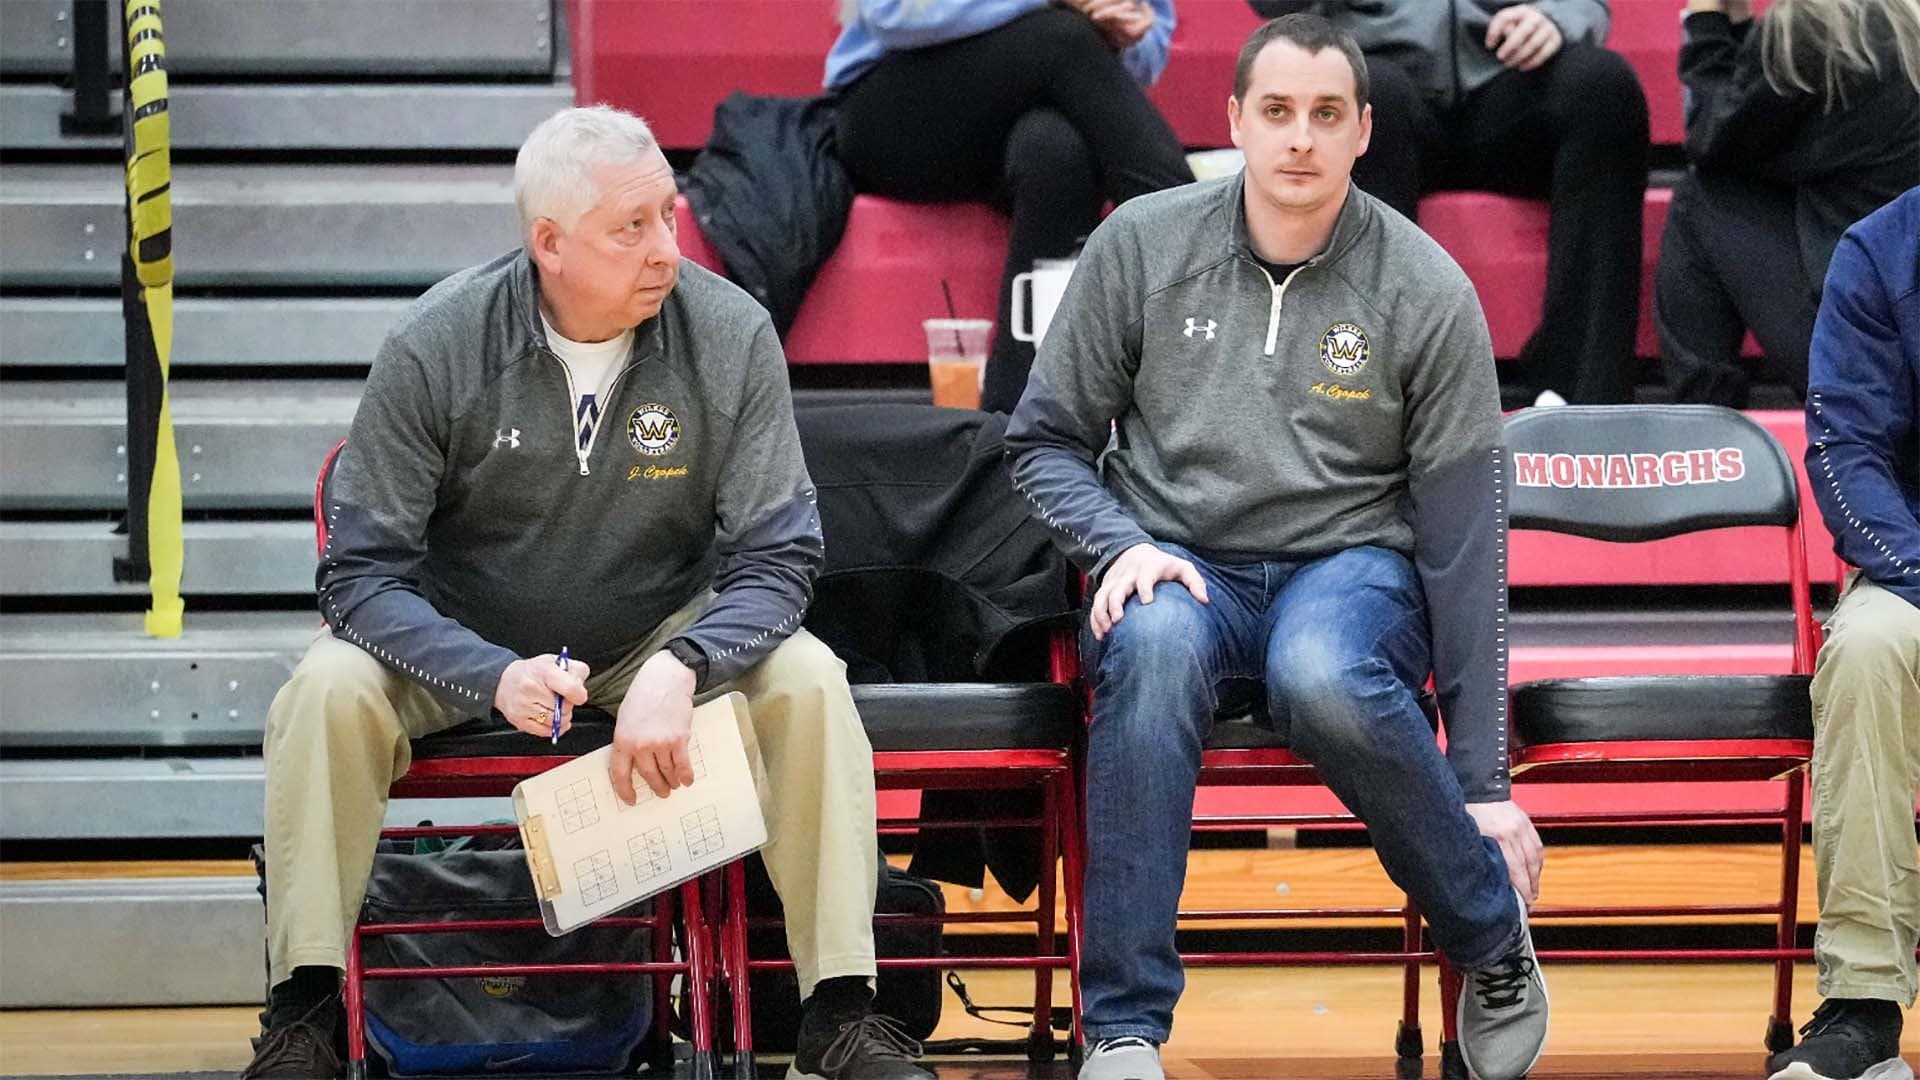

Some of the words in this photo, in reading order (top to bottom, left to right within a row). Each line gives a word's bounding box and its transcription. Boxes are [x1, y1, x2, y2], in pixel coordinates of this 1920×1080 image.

[1327, 337, 1365, 360] W
[632, 419, 674, 440] W
[1513, 447, 1745, 489] MONARCHS
